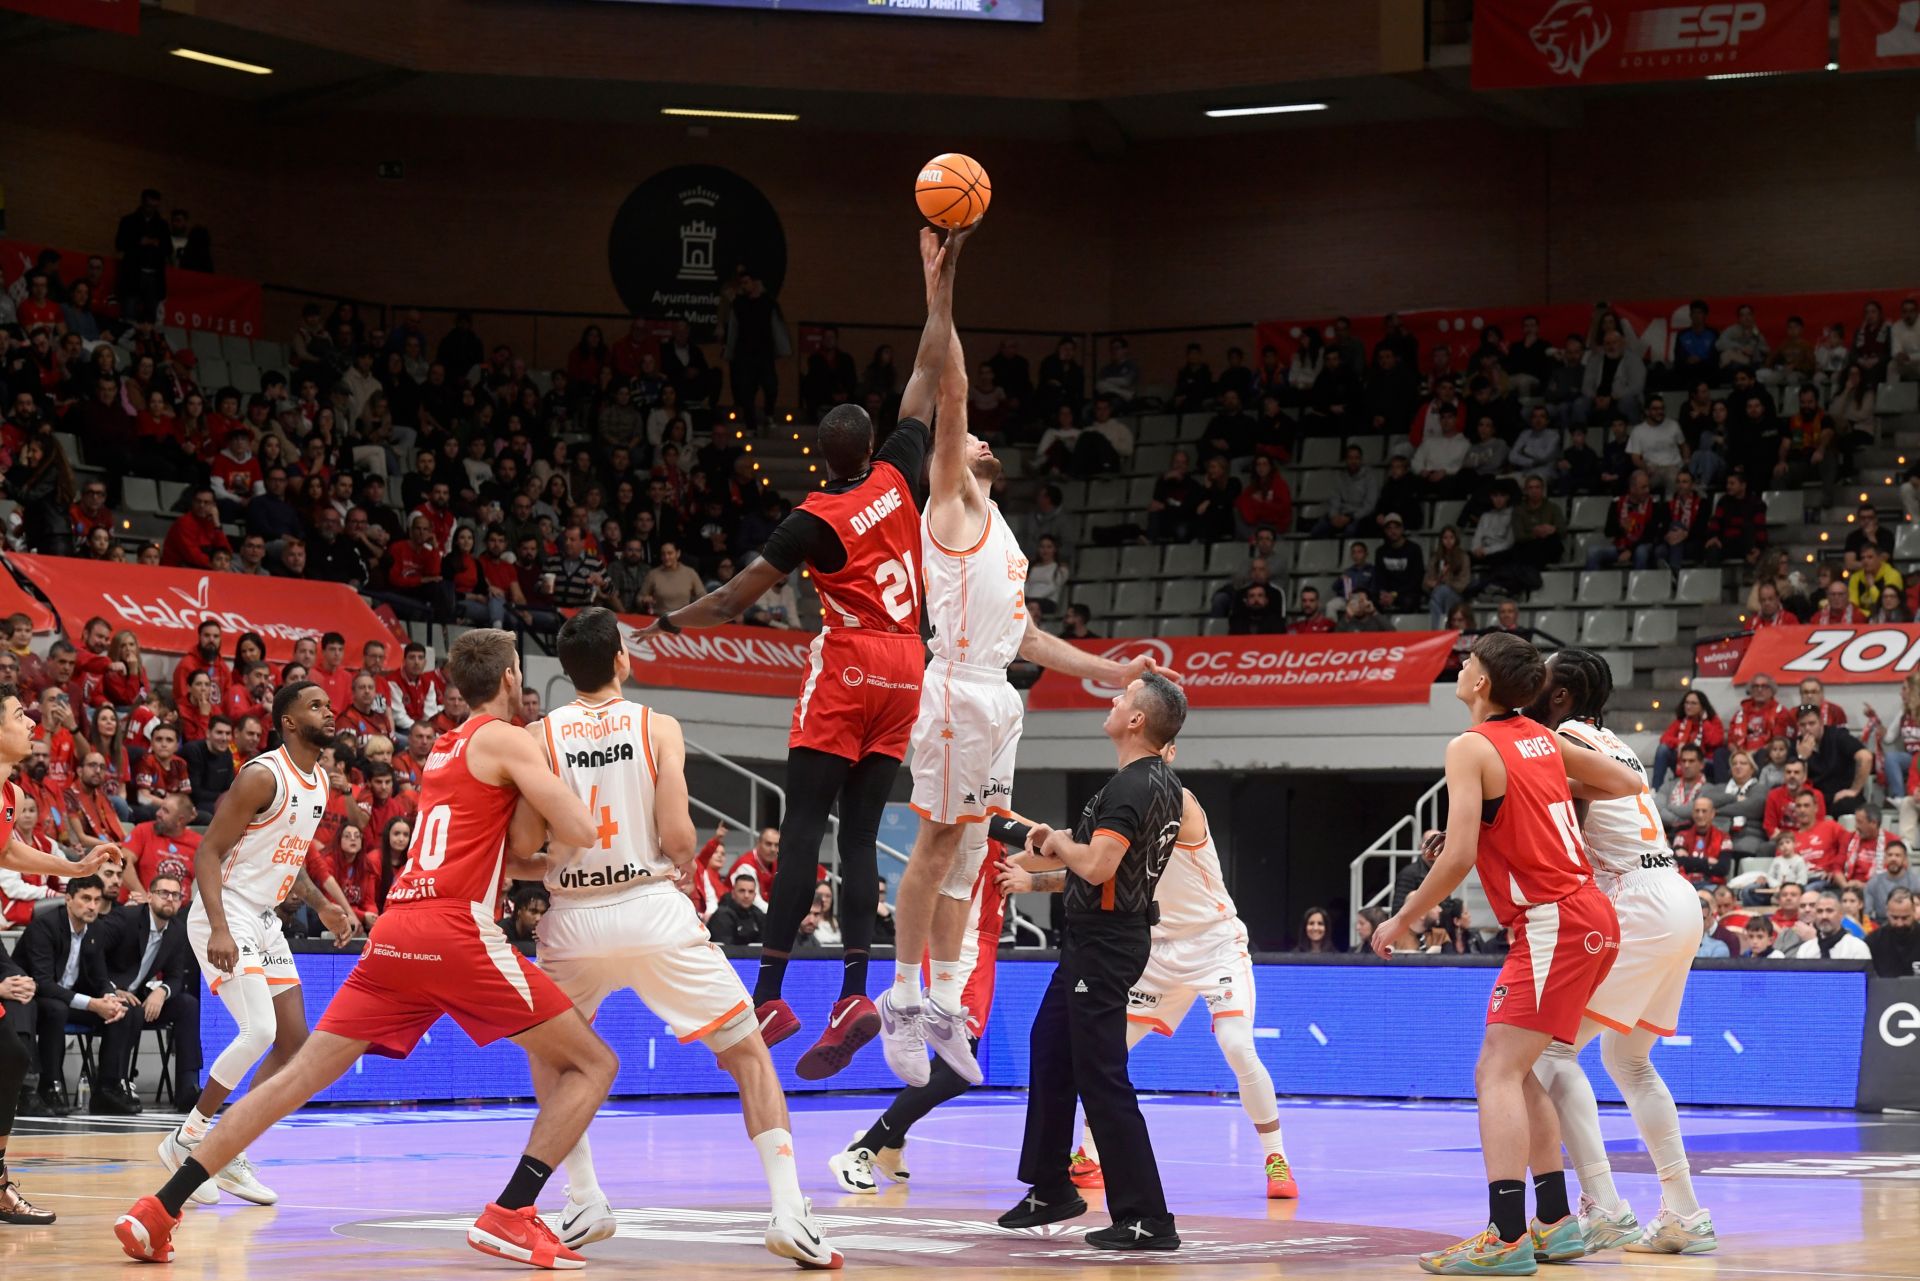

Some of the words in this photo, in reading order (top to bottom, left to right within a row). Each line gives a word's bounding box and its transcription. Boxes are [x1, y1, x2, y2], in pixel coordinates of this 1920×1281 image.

[889, 0, 928, 8] PEDRO
[1676, 3, 1767, 48] ESP
[1619, 50, 1739, 69] SOLUTIONS
[174, 309, 255, 337] ODISEO
[849, 487, 903, 536] DIAGNE
[875, 550, 919, 622] 21
[1186, 651, 1230, 671] OC
[1235, 646, 1406, 670] Soluciones
[1718, 663, 1729, 671] 11
[1177, 666, 1397, 687] Medioambientales
[561, 715, 632, 741] PRADILLA
[565, 743, 634, 768] PAMESA
[1514, 736, 1556, 759] NEVES
[589, 785, 619, 850] 4
[1547, 800, 1584, 867] 14
[276, 874, 295, 901] 8
[413, 953, 442, 961] MURCIA
